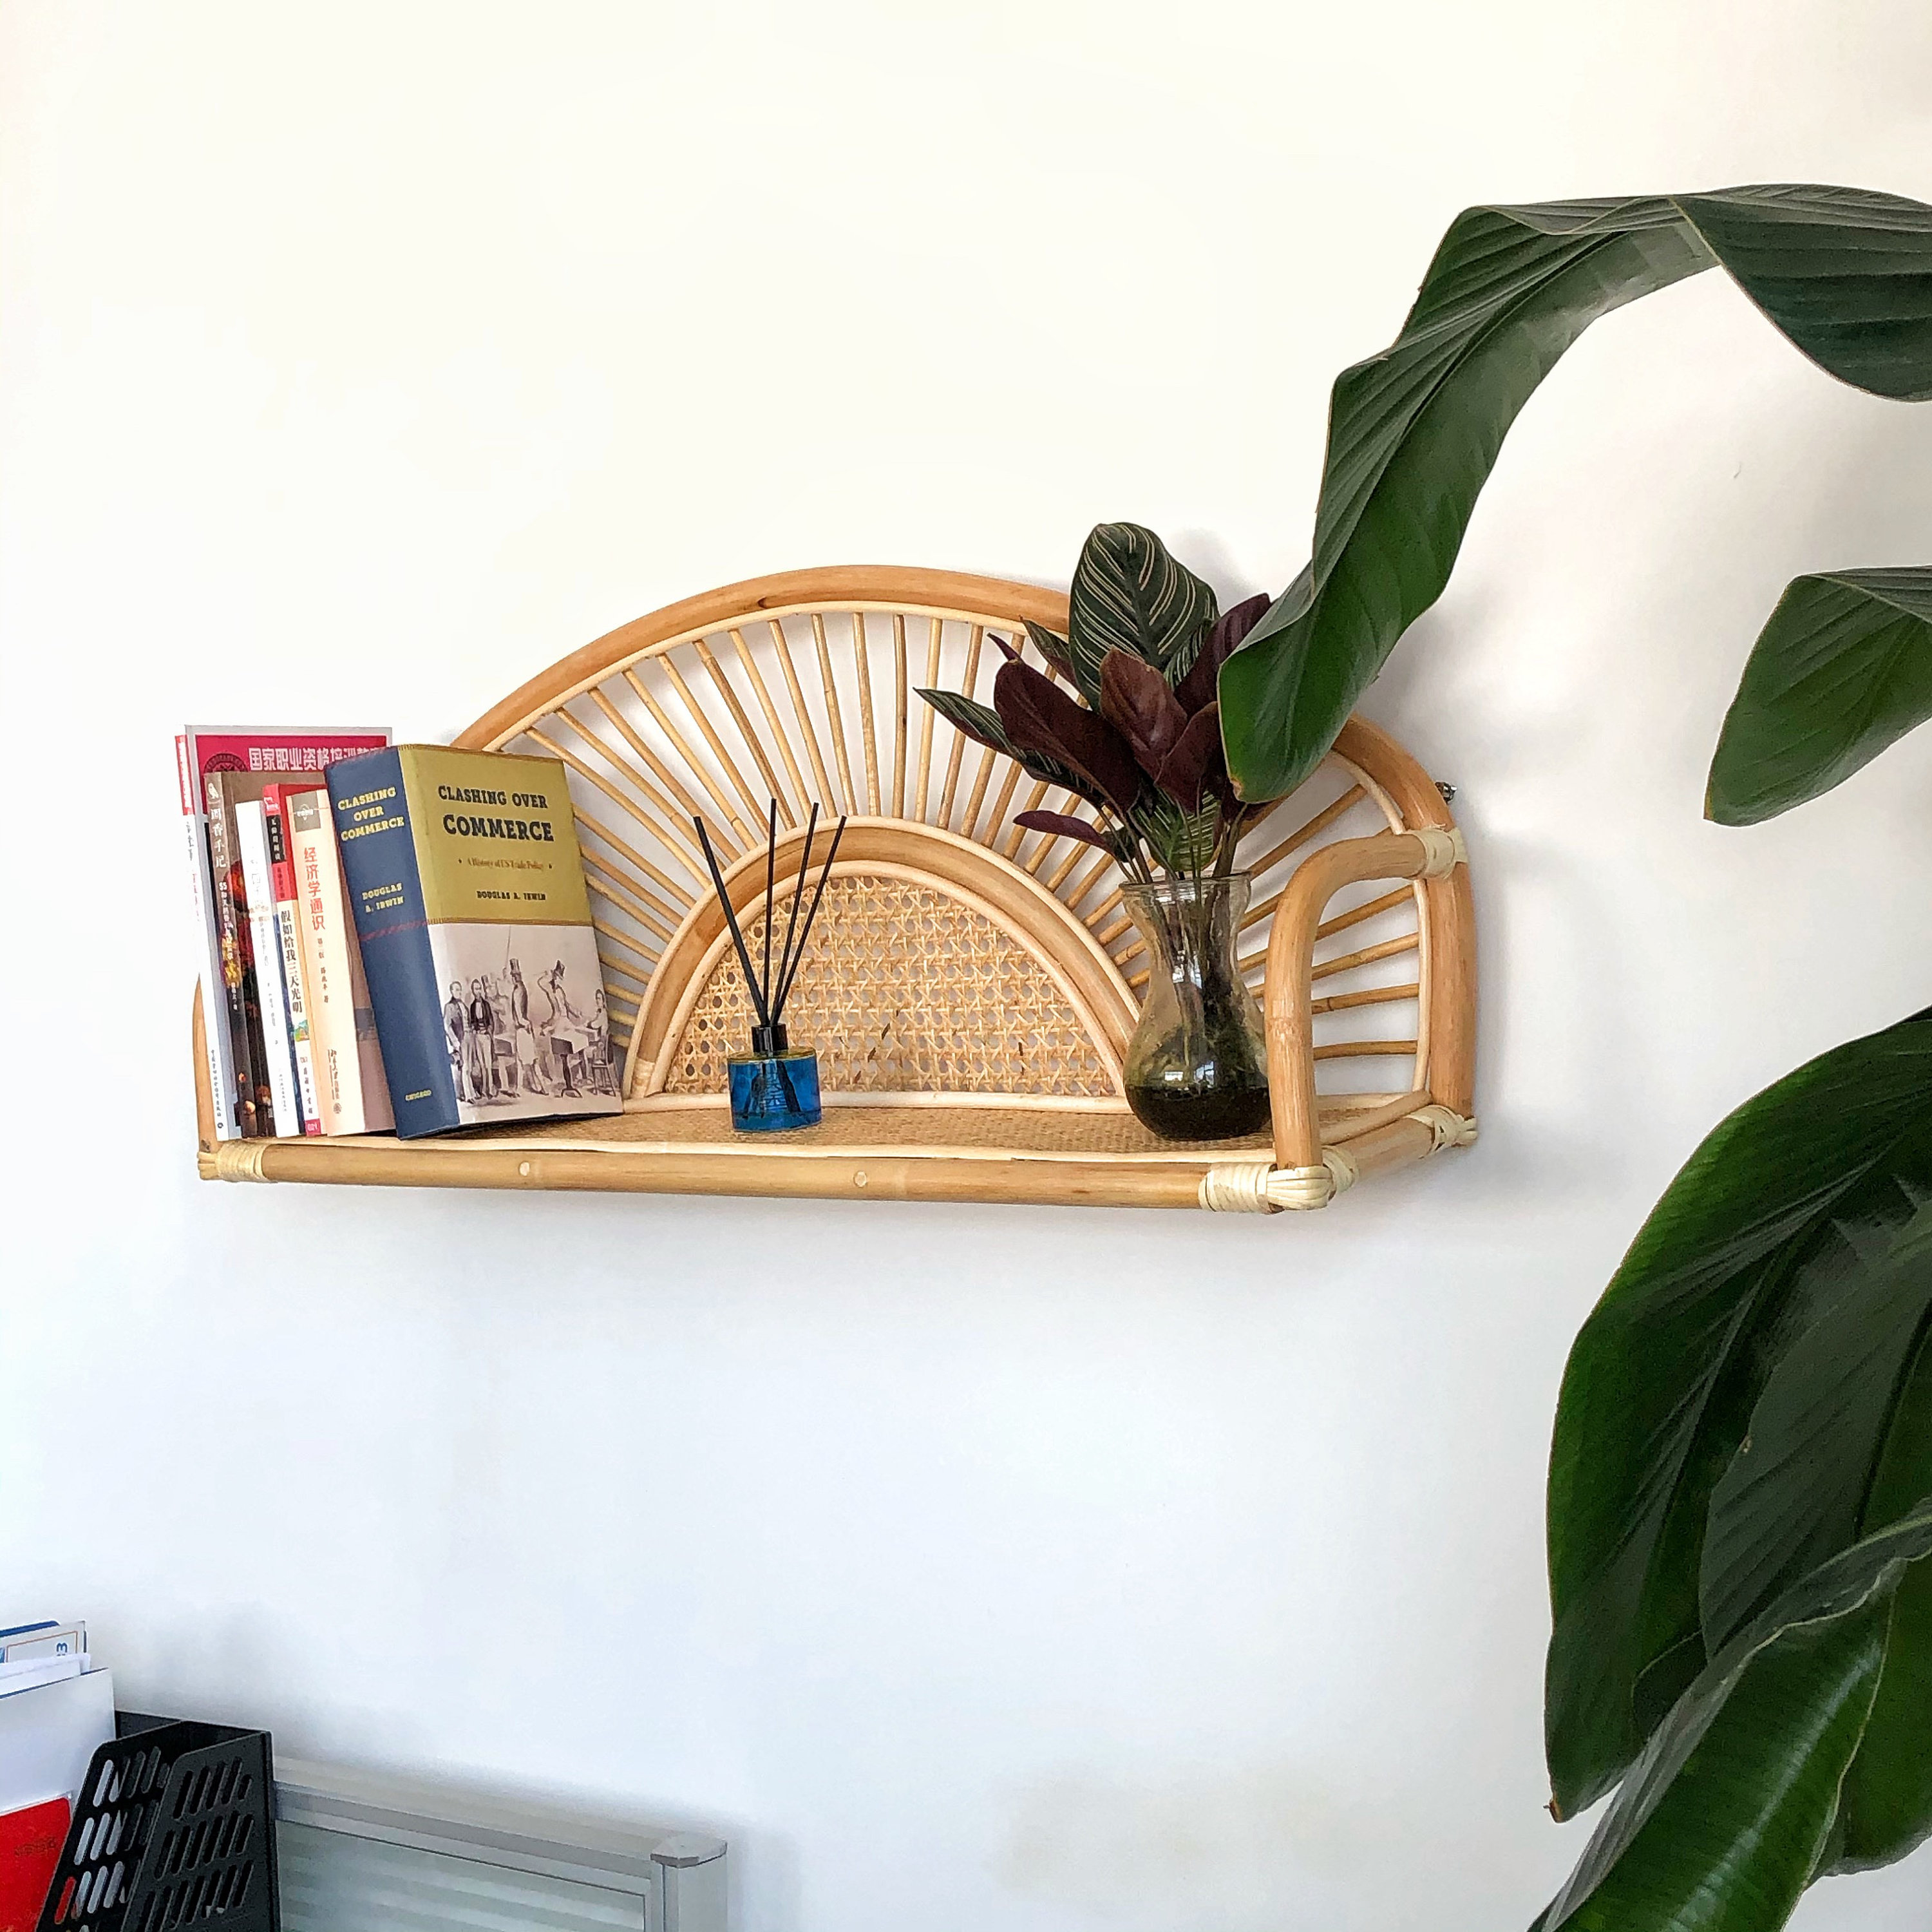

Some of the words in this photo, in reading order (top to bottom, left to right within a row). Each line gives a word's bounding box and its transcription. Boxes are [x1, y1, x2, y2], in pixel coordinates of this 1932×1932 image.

[249, 747, 386, 771] 国家职业资格培
[337, 787, 397, 811] CLASHING
[438, 785, 507, 806] CLASHING
[511, 793, 548, 809] OVER
[354, 806, 384, 822] OVER
[341, 816, 405, 842] COMMERCE
[443, 814, 554, 842] COMMERCE
[304, 846, 326, 931] 经济学通识
[362, 882, 402, 900] DOUGLAS
[477, 891, 511, 900] DOUGLAS
[376, 896, 404, 910] IRWIN
[280, 910, 303, 1014] 假如给我三天光明
